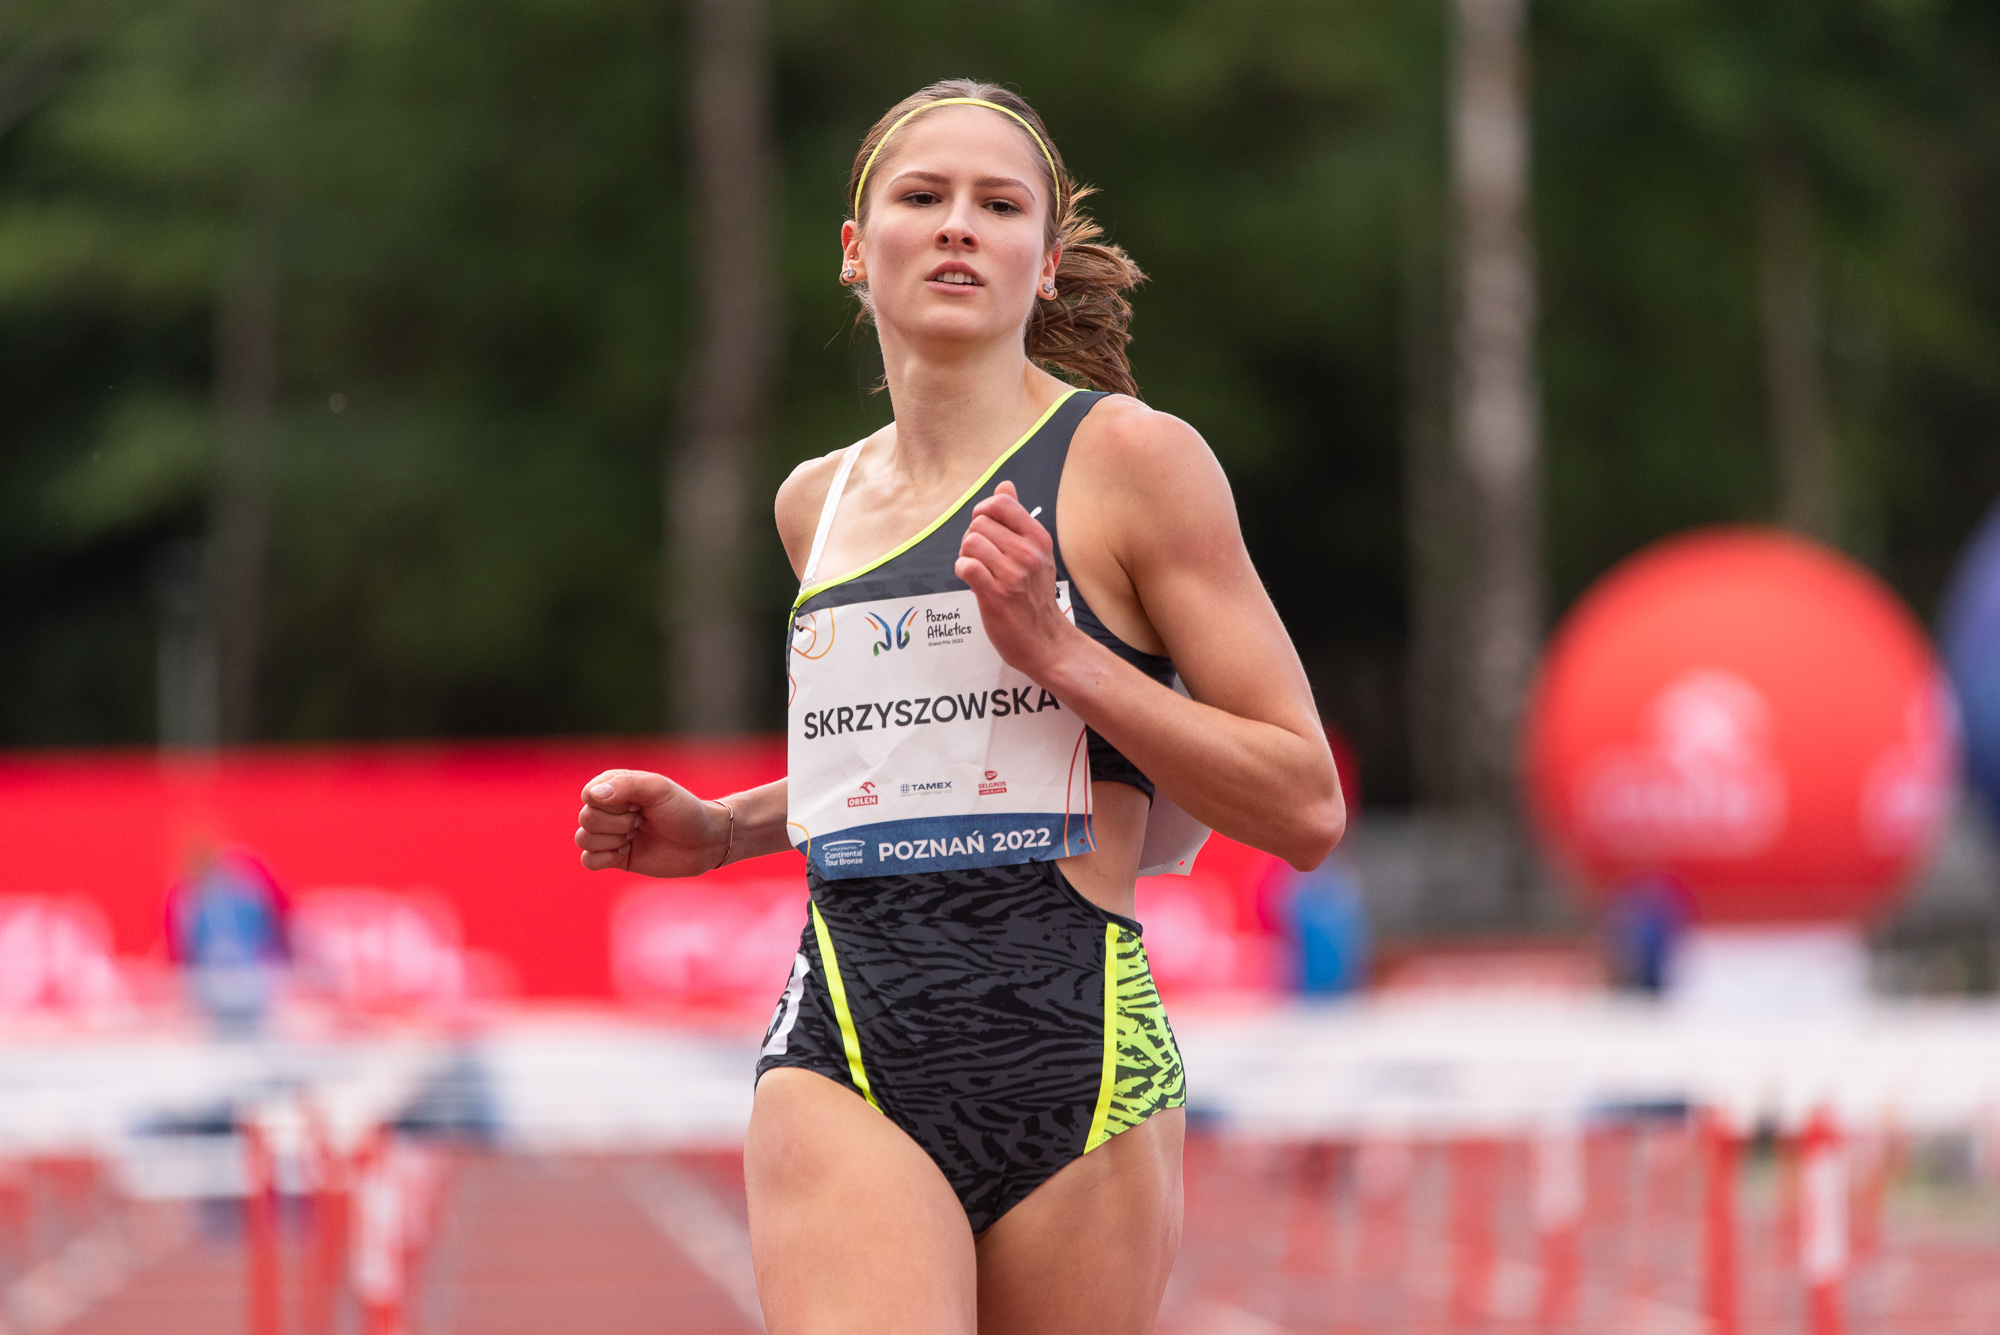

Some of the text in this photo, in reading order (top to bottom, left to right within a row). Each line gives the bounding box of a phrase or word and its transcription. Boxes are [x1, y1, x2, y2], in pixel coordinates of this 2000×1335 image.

[926, 608, 960, 623] Poznań
[927, 623, 972, 639] Athletics
[803, 686, 1061, 740] SKRZYSZOWSKA
[911, 781, 952, 791] TAMEX
[978, 781, 1006, 789] SELGROS
[848, 796, 876, 807] ORLEN
[878, 827, 1052, 862] POZNAŃ 2022
[825, 850, 863, 859] Continental
[840, 858, 863, 866] Bronze
